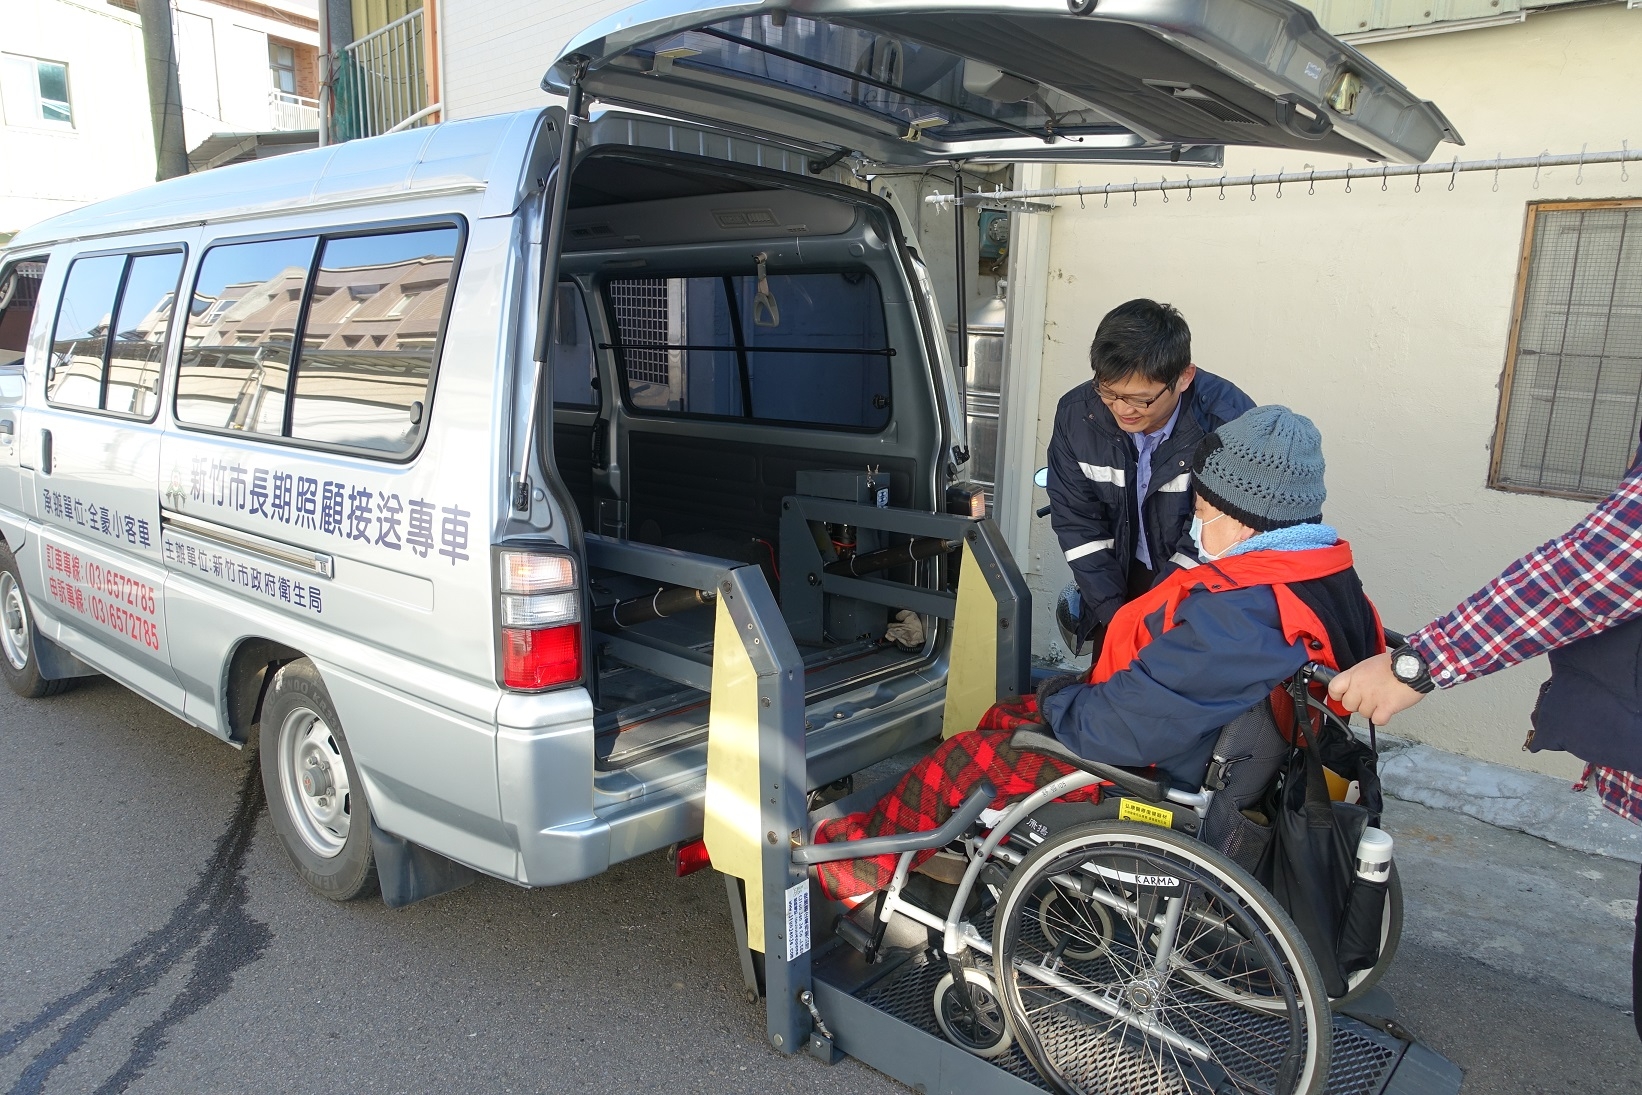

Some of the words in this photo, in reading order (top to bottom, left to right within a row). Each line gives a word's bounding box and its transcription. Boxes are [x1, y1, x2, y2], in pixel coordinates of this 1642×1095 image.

[189, 455, 471, 567] 新竹市長期照顧接送專車
[165, 539, 322, 614] 主辦單位:新竹市政府衛生局
[1135, 875, 1175, 886] KARMA
